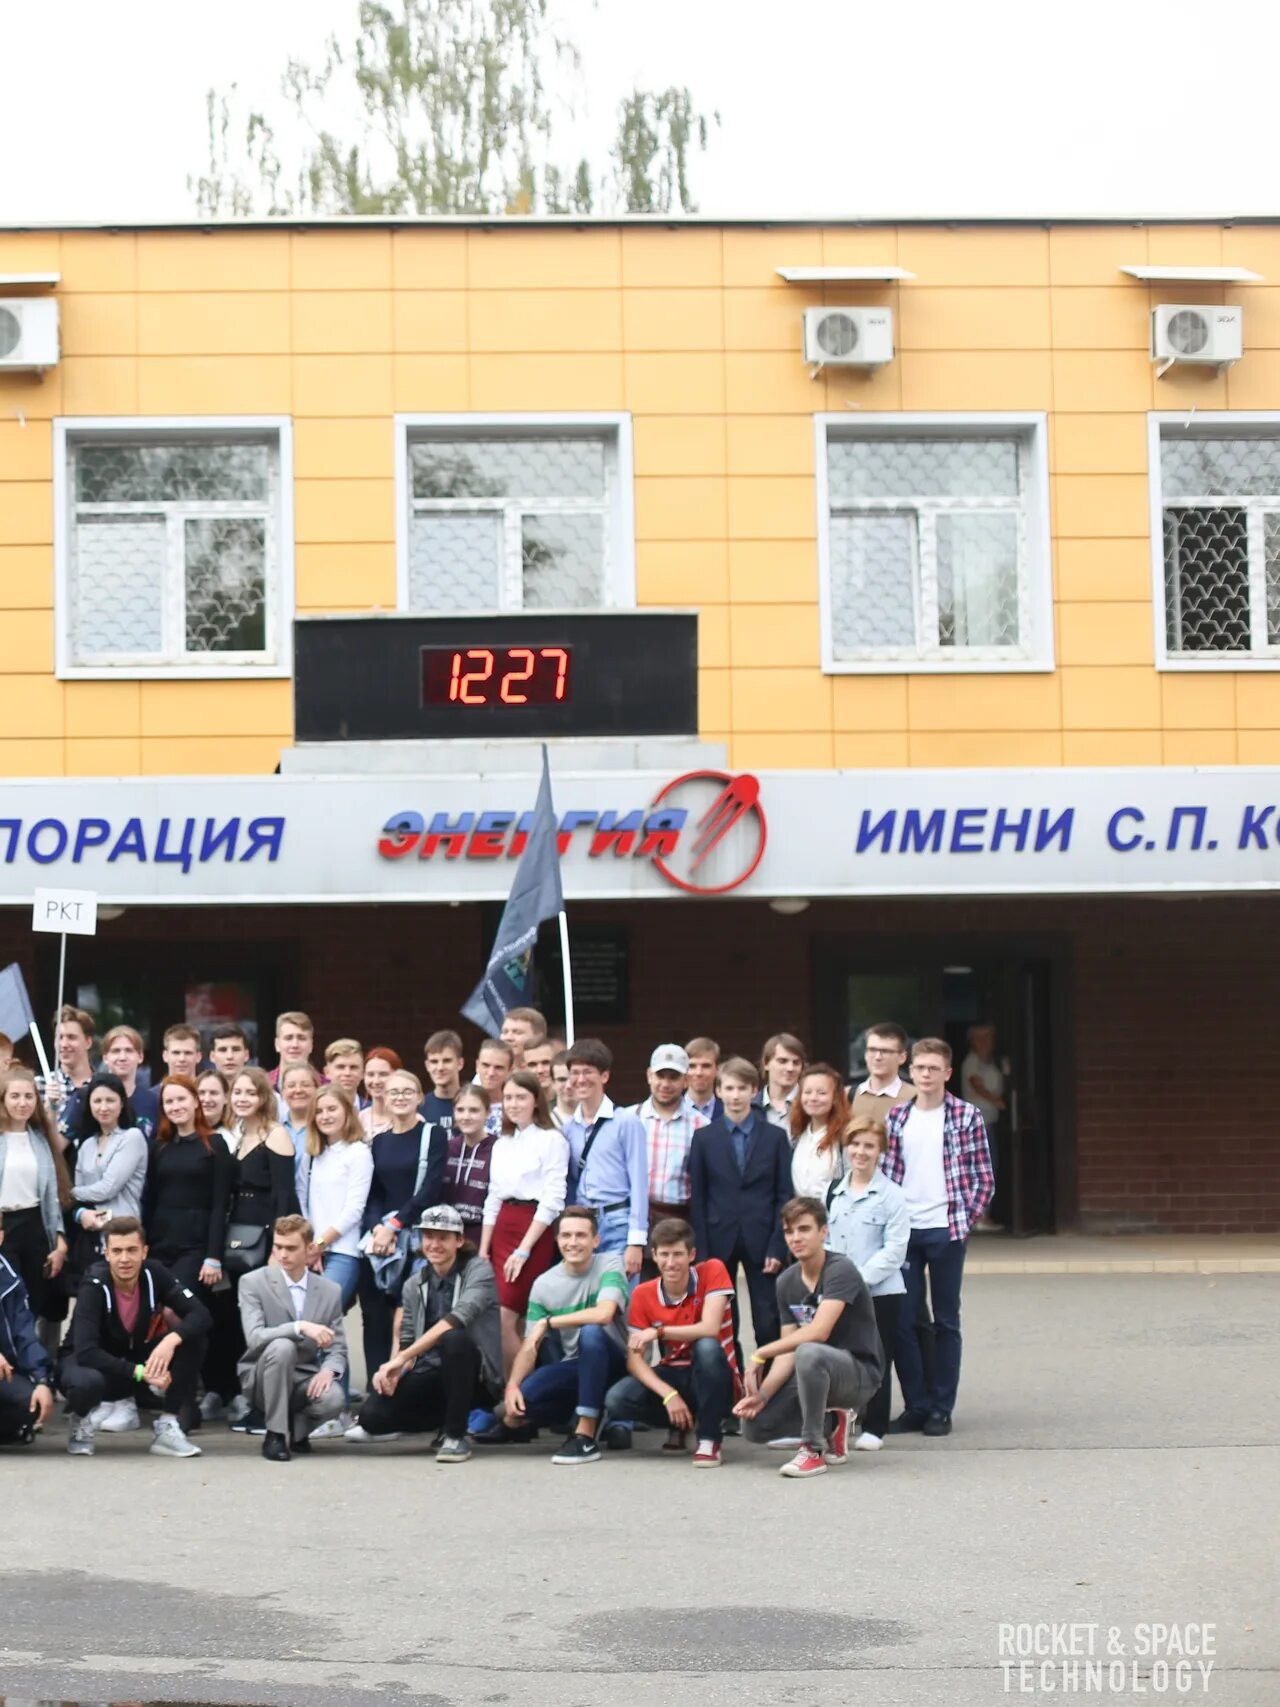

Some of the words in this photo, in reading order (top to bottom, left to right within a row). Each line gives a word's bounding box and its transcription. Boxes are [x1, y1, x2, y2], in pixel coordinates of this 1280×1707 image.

[856, 808, 1074, 853] ИМЕНИ
[1107, 807, 1218, 851] С.П.
[1238, 805, 1280, 849] К
[47, 901, 84, 920] РКТ
